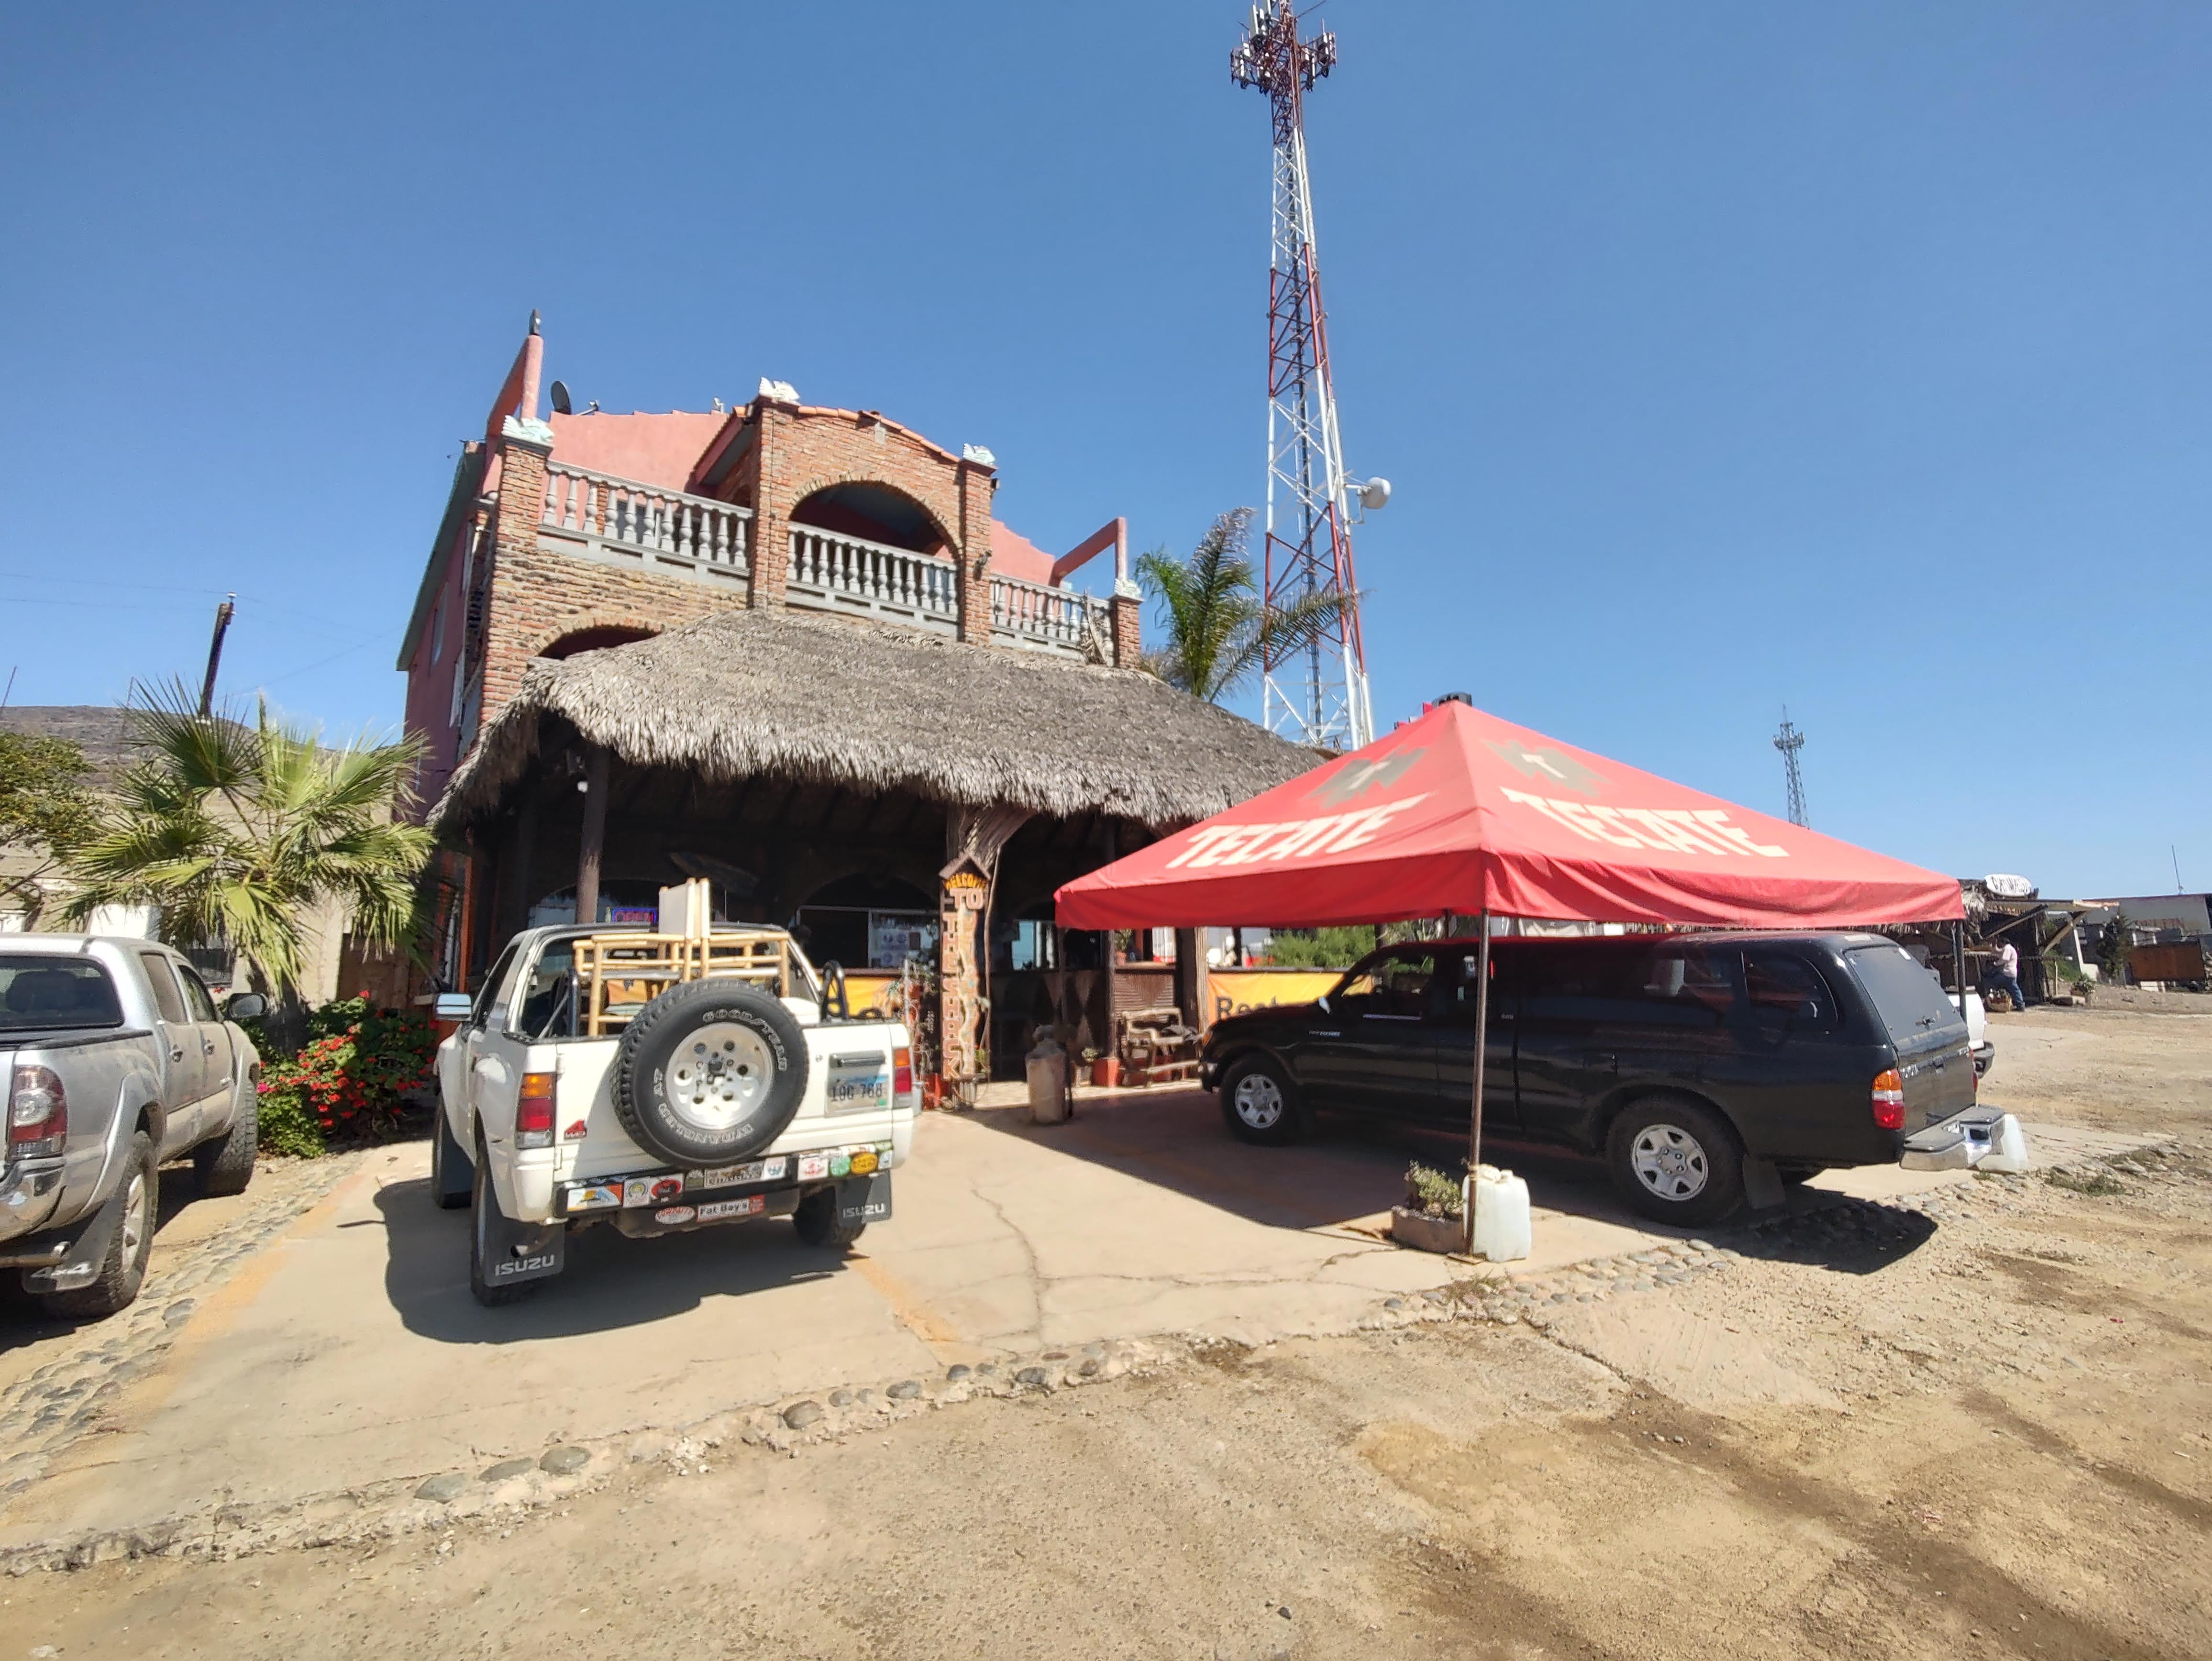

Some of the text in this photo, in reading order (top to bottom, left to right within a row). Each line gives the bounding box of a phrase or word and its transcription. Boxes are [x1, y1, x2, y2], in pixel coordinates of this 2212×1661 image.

[1165, 790, 1436, 869] TECATE
[1499, 786, 1790, 858] TECATE
[943, 873, 987, 891] WELCOME
[950, 887, 984, 909] TO
[942, 912, 958, 973] THE
[702, 1008, 788, 1072] GOODYEAR
[942, 978, 960, 1080] SHACK
[658, 1102, 754, 1144] WRANGLER
[842, 1203, 884, 1218] ISUZU
[495, 1254, 554, 1276] ISUZU
